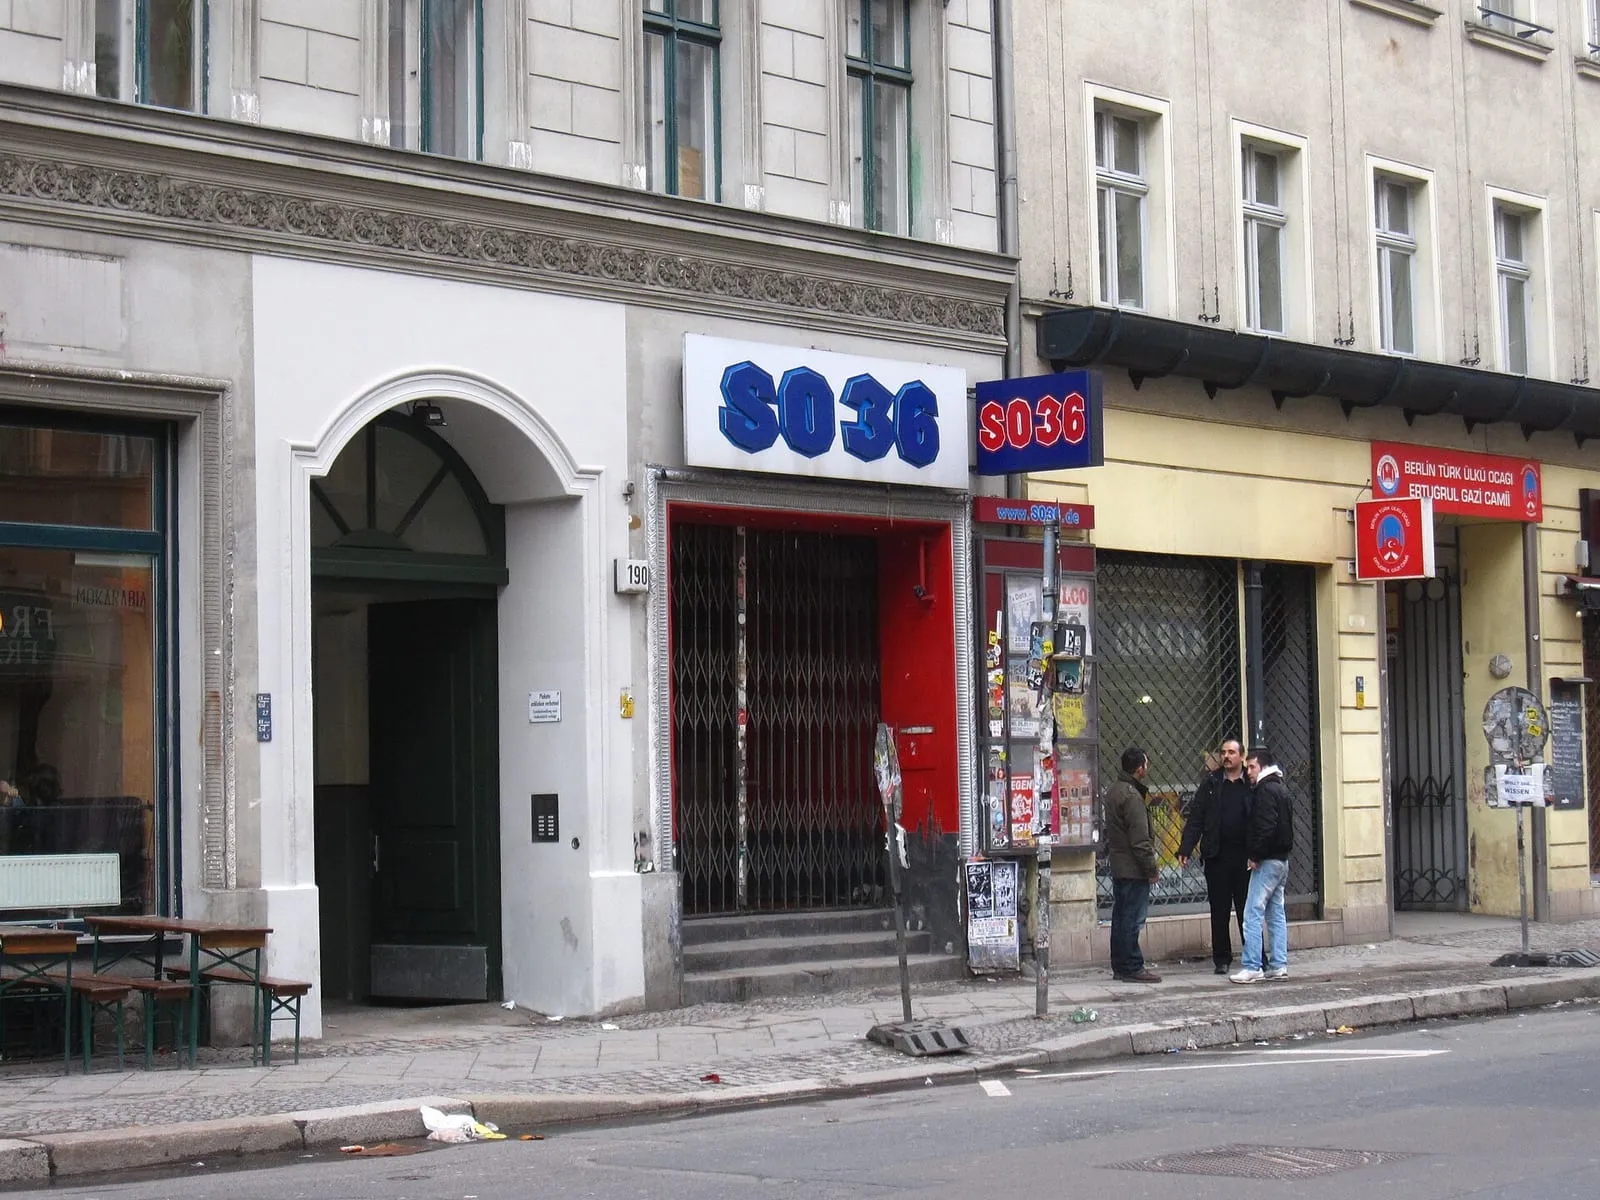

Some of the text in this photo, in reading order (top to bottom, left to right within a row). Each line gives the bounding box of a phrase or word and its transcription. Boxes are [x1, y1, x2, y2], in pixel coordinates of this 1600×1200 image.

[1438, 462, 1462, 479] TÜRK
[1463, 465, 1487, 482] ÜLKÜ
[627, 564, 648, 585] 190
